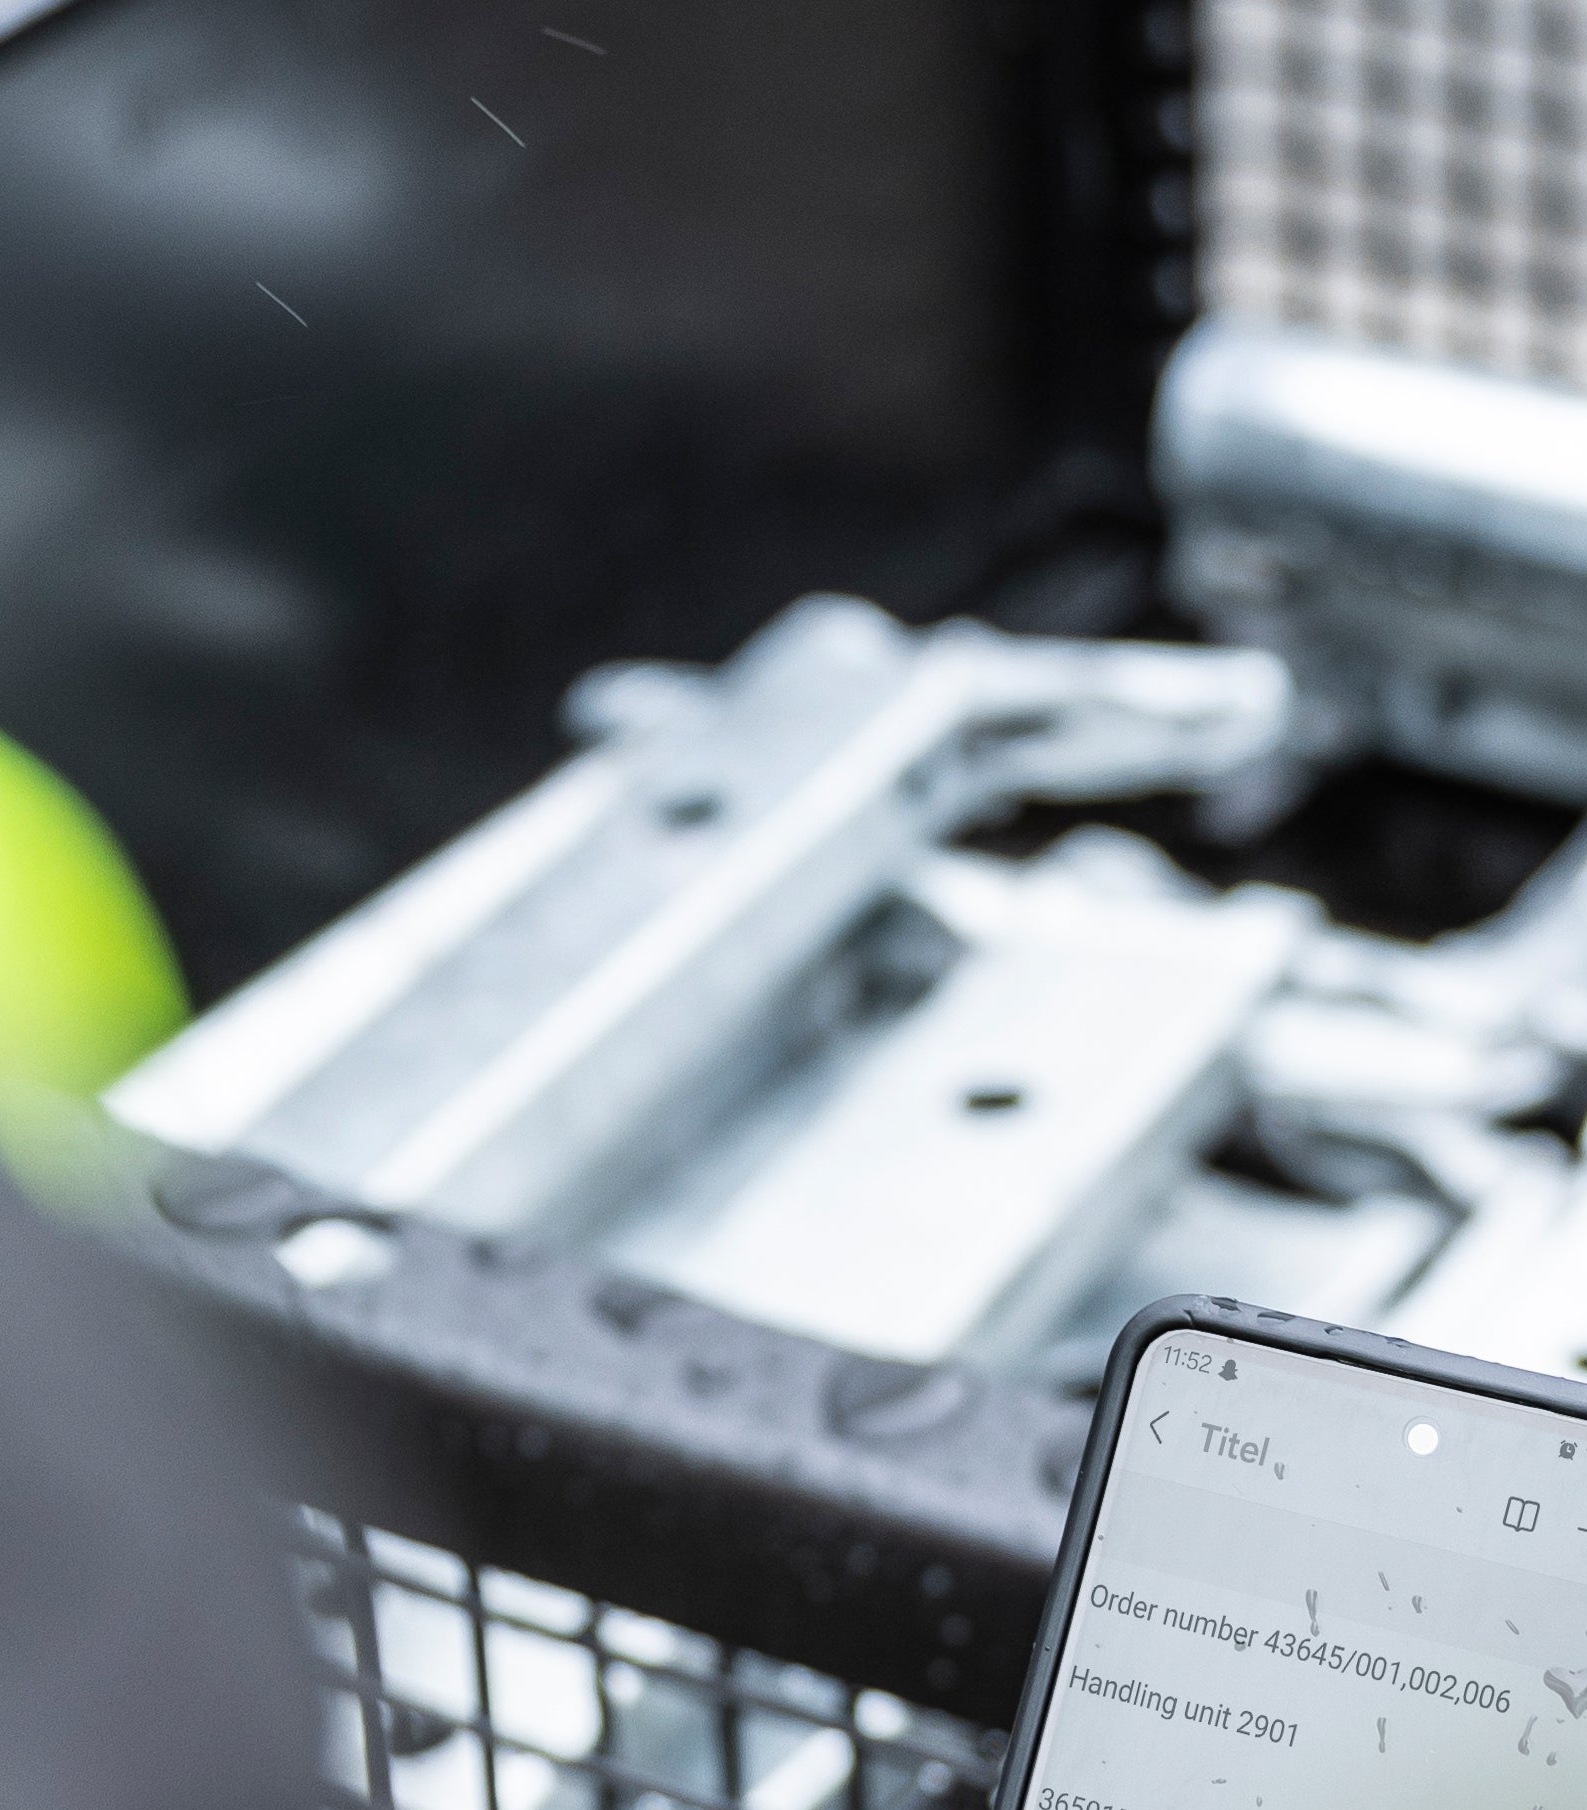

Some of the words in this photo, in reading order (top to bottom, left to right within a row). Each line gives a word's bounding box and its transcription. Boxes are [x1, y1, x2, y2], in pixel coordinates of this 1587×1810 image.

[1164, 1346, 1212, 1374] 11:52
[1201, 1422, 1270, 1466] Titel
[1090, 1584, 1158, 1621] Order
[1163, 1606, 1259, 1648] number
[1264, 1630, 1510, 1713] 43645/001,002,006
[1069, 1665, 1178, 1720] Handling
[1184, 1701, 1232, 1730] unit
[1236, 1711, 1298, 1747] 2901
